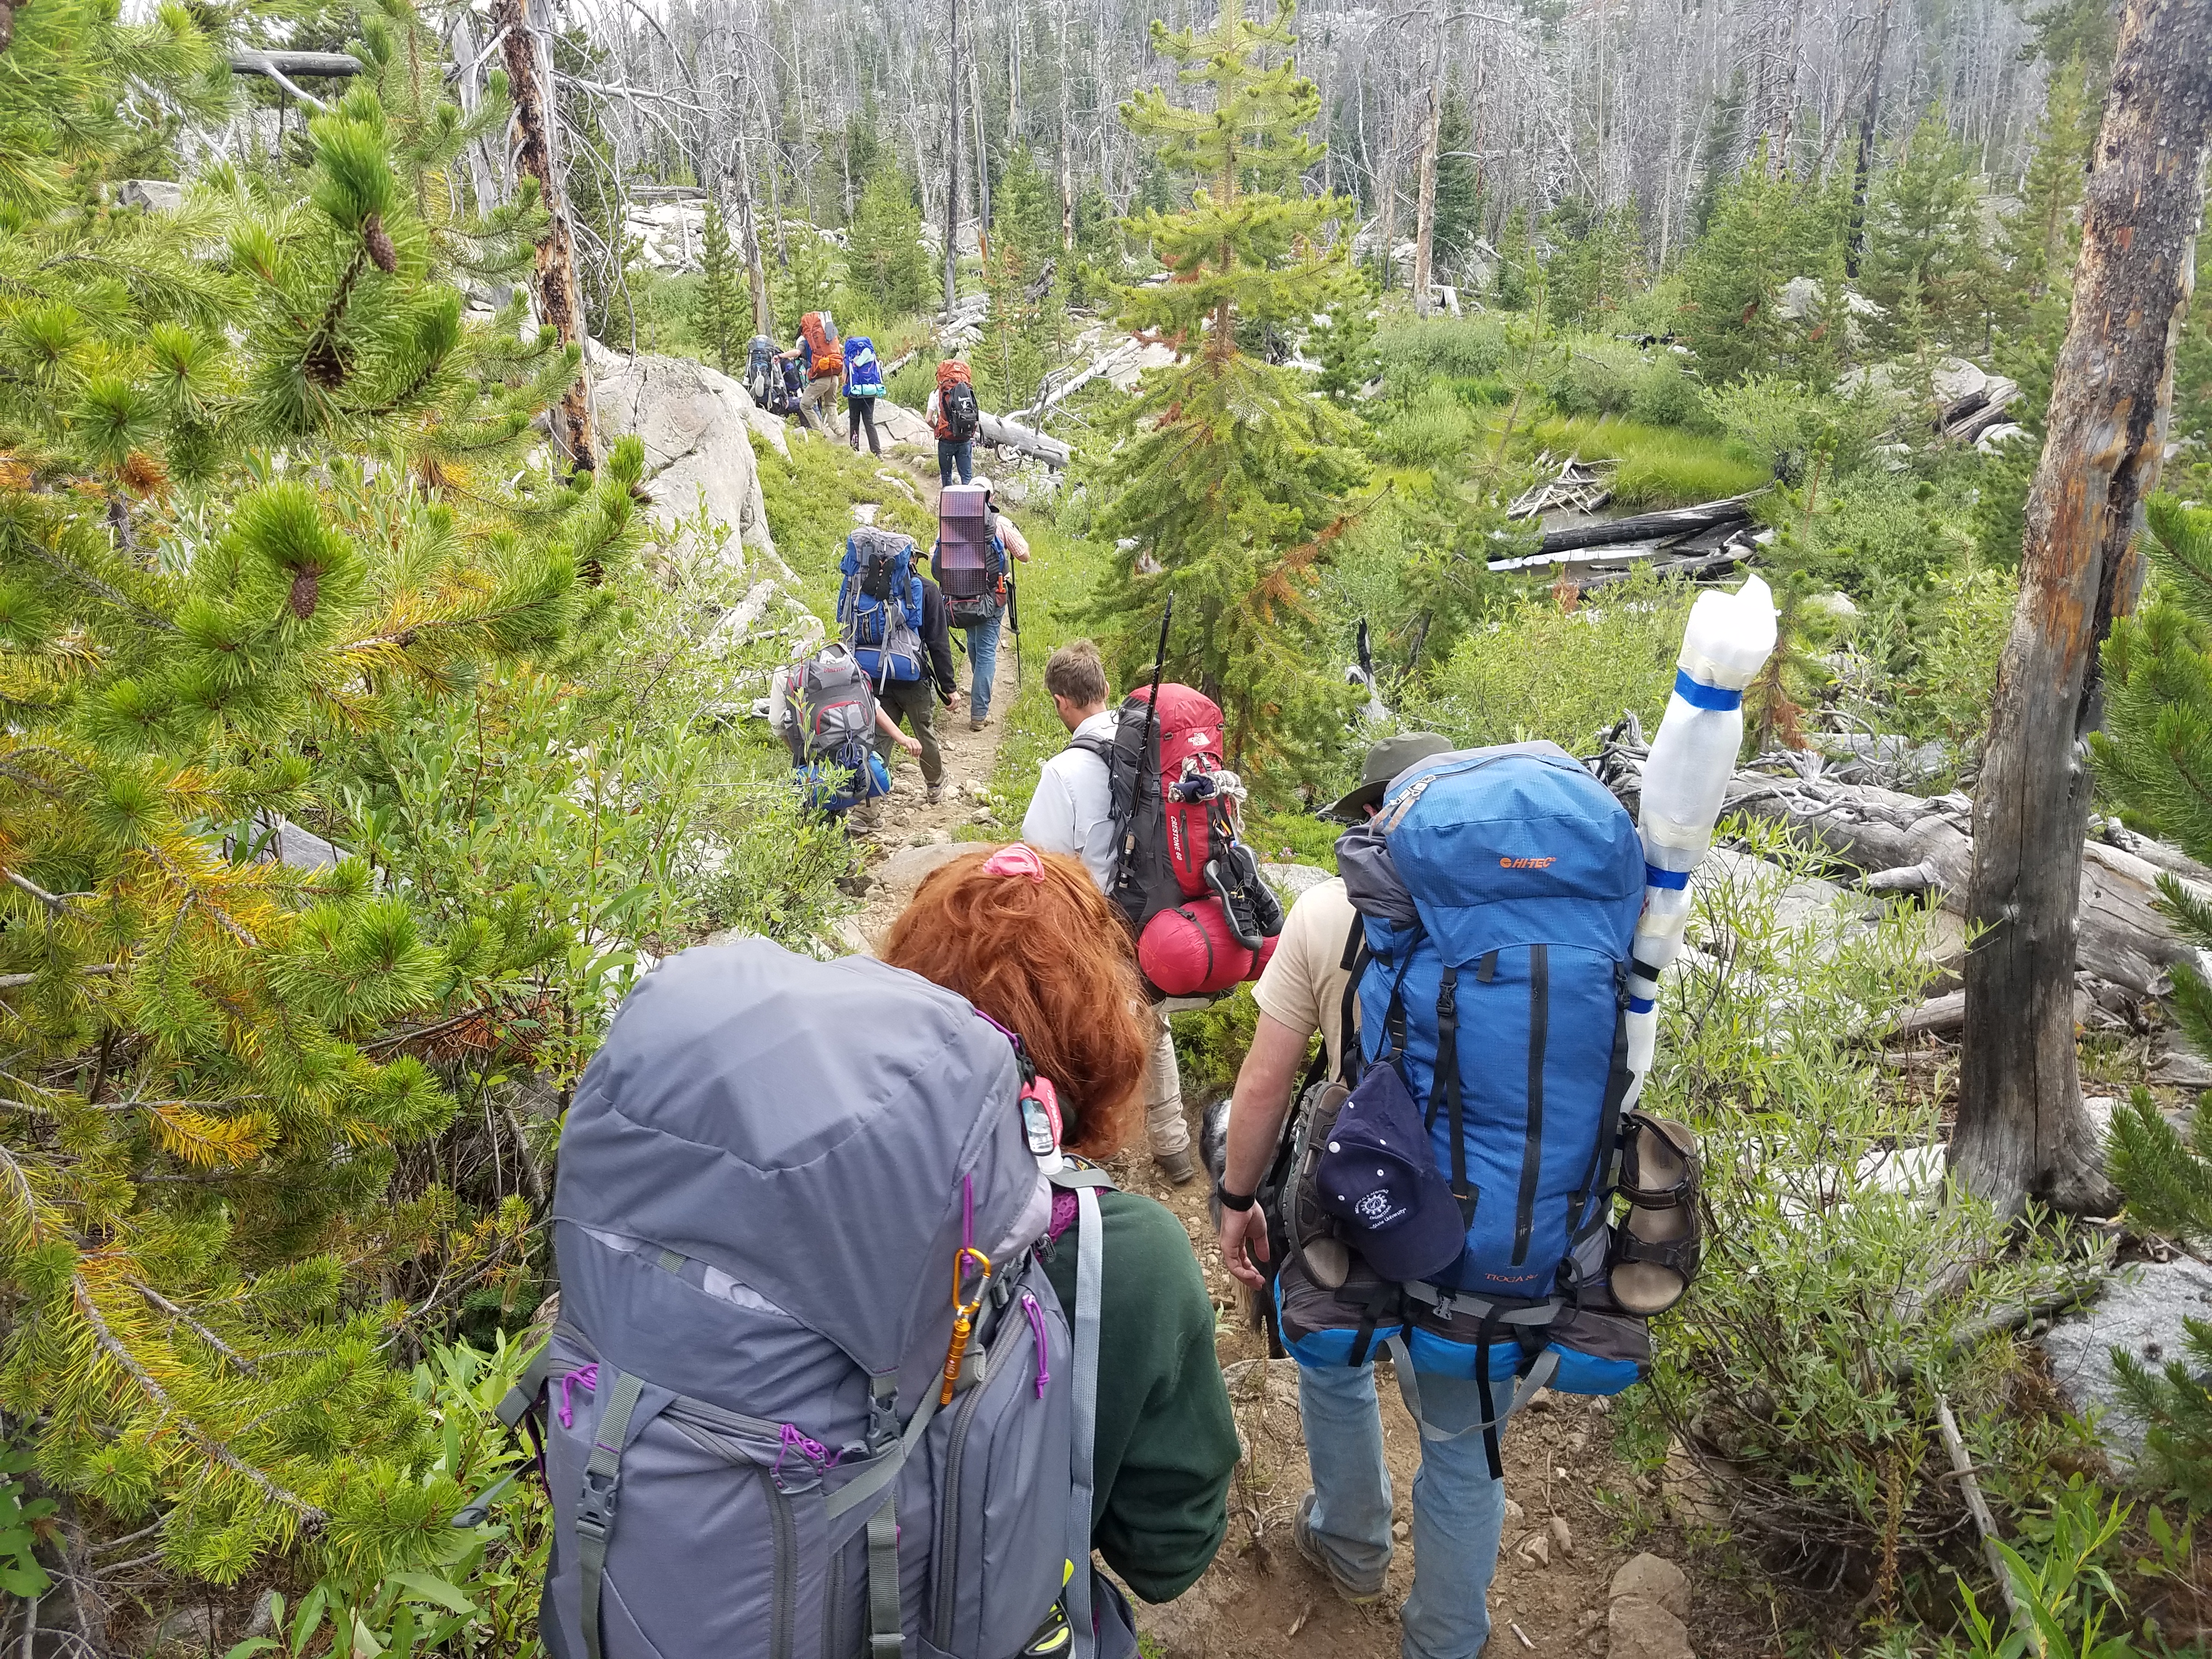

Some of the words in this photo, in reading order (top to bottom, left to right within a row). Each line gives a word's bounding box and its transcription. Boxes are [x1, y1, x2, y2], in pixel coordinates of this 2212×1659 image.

[1171, 815, 1181, 851] CRESTONE
[1176, 851, 1183, 861] 60
[1512, 857, 1551, 868] HI-TEC
[1372, 1220, 1385, 1229] State
